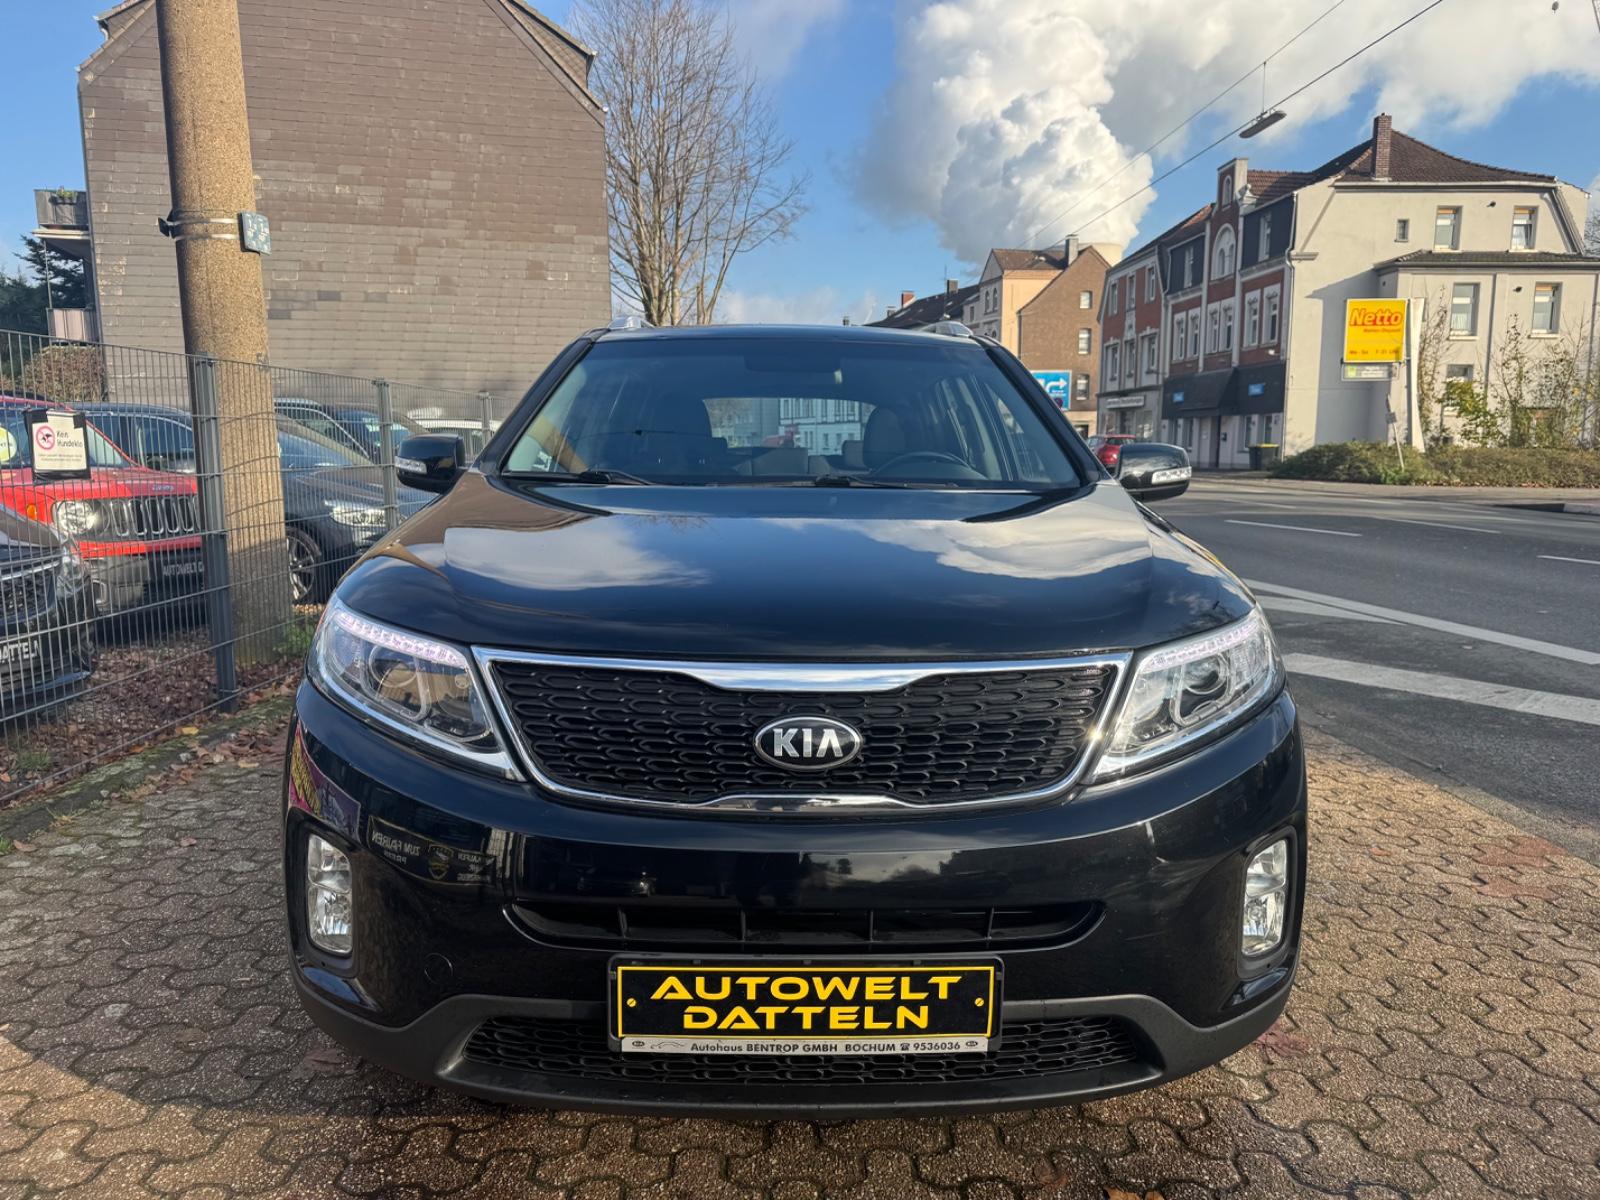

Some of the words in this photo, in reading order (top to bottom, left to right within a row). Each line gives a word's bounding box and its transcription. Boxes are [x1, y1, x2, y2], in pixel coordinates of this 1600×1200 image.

[1349, 308, 1402, 326] Netto
[773, 728, 843, 757] KIA
[650, 976, 962, 1000] AUTOWELT
[683, 1005, 929, 1030] DATTELN
[690, 1042, 743, 1053] Autohaus
[747, 1043, 799, 1053] BENTROP
[803, 1043, 838, 1053] GMBH
[844, 1043, 896, 1053] BOCHUM
[912, 1041, 961, 1052] 9536036
